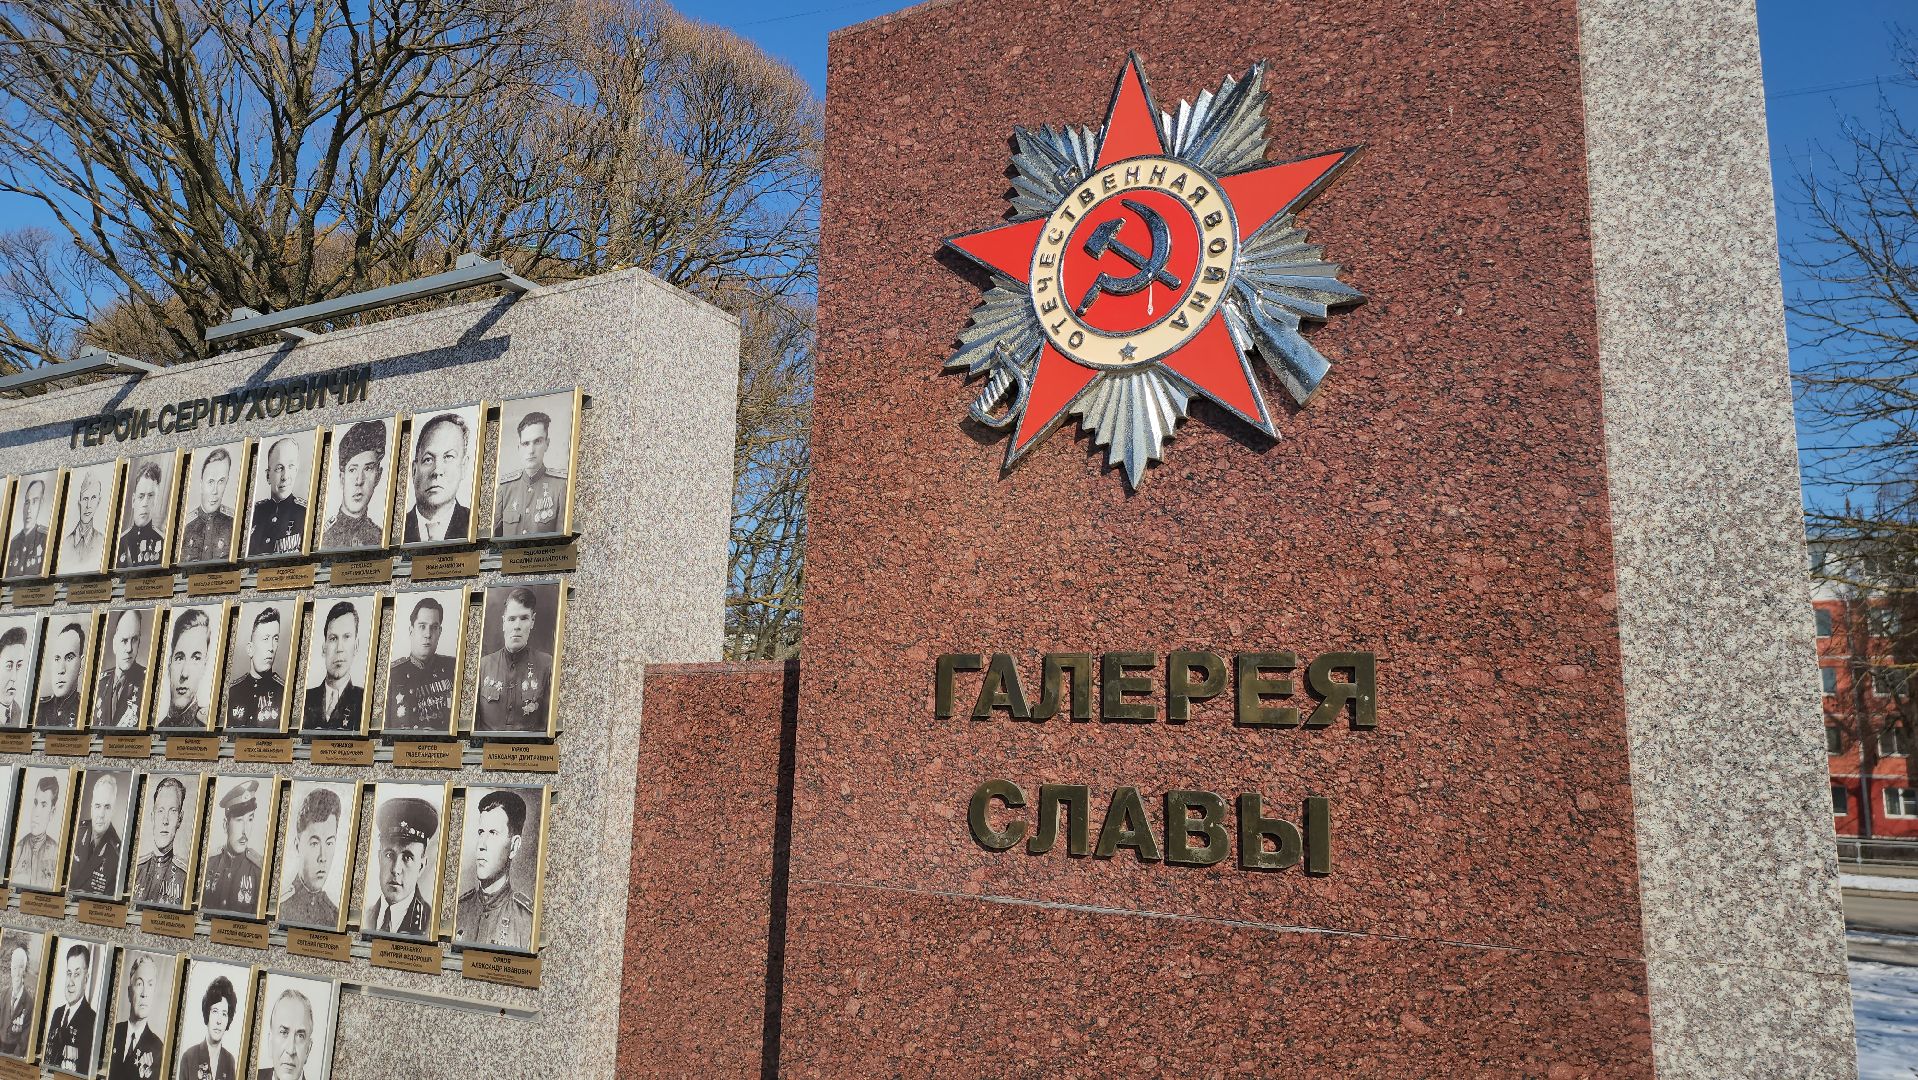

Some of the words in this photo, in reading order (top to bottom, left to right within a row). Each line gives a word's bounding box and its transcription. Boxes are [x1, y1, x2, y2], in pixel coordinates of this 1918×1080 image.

[1037, 164, 1210, 350] ОТЕЧЕСТВЕННАЯ
[1169, 210, 1227, 331] ВОЙНА
[70, 366, 371, 450] ГЕРОИ-СЕРПУХОВИЧИ
[935, 651, 1377, 728] ГАЛЕРЕЯ
[968, 778, 1331, 875] СЛАВЫ
[471, 962, 503, 972] АЛЕКСАНДР
[503, 966, 533, 976] ИВАНОВИЧ
